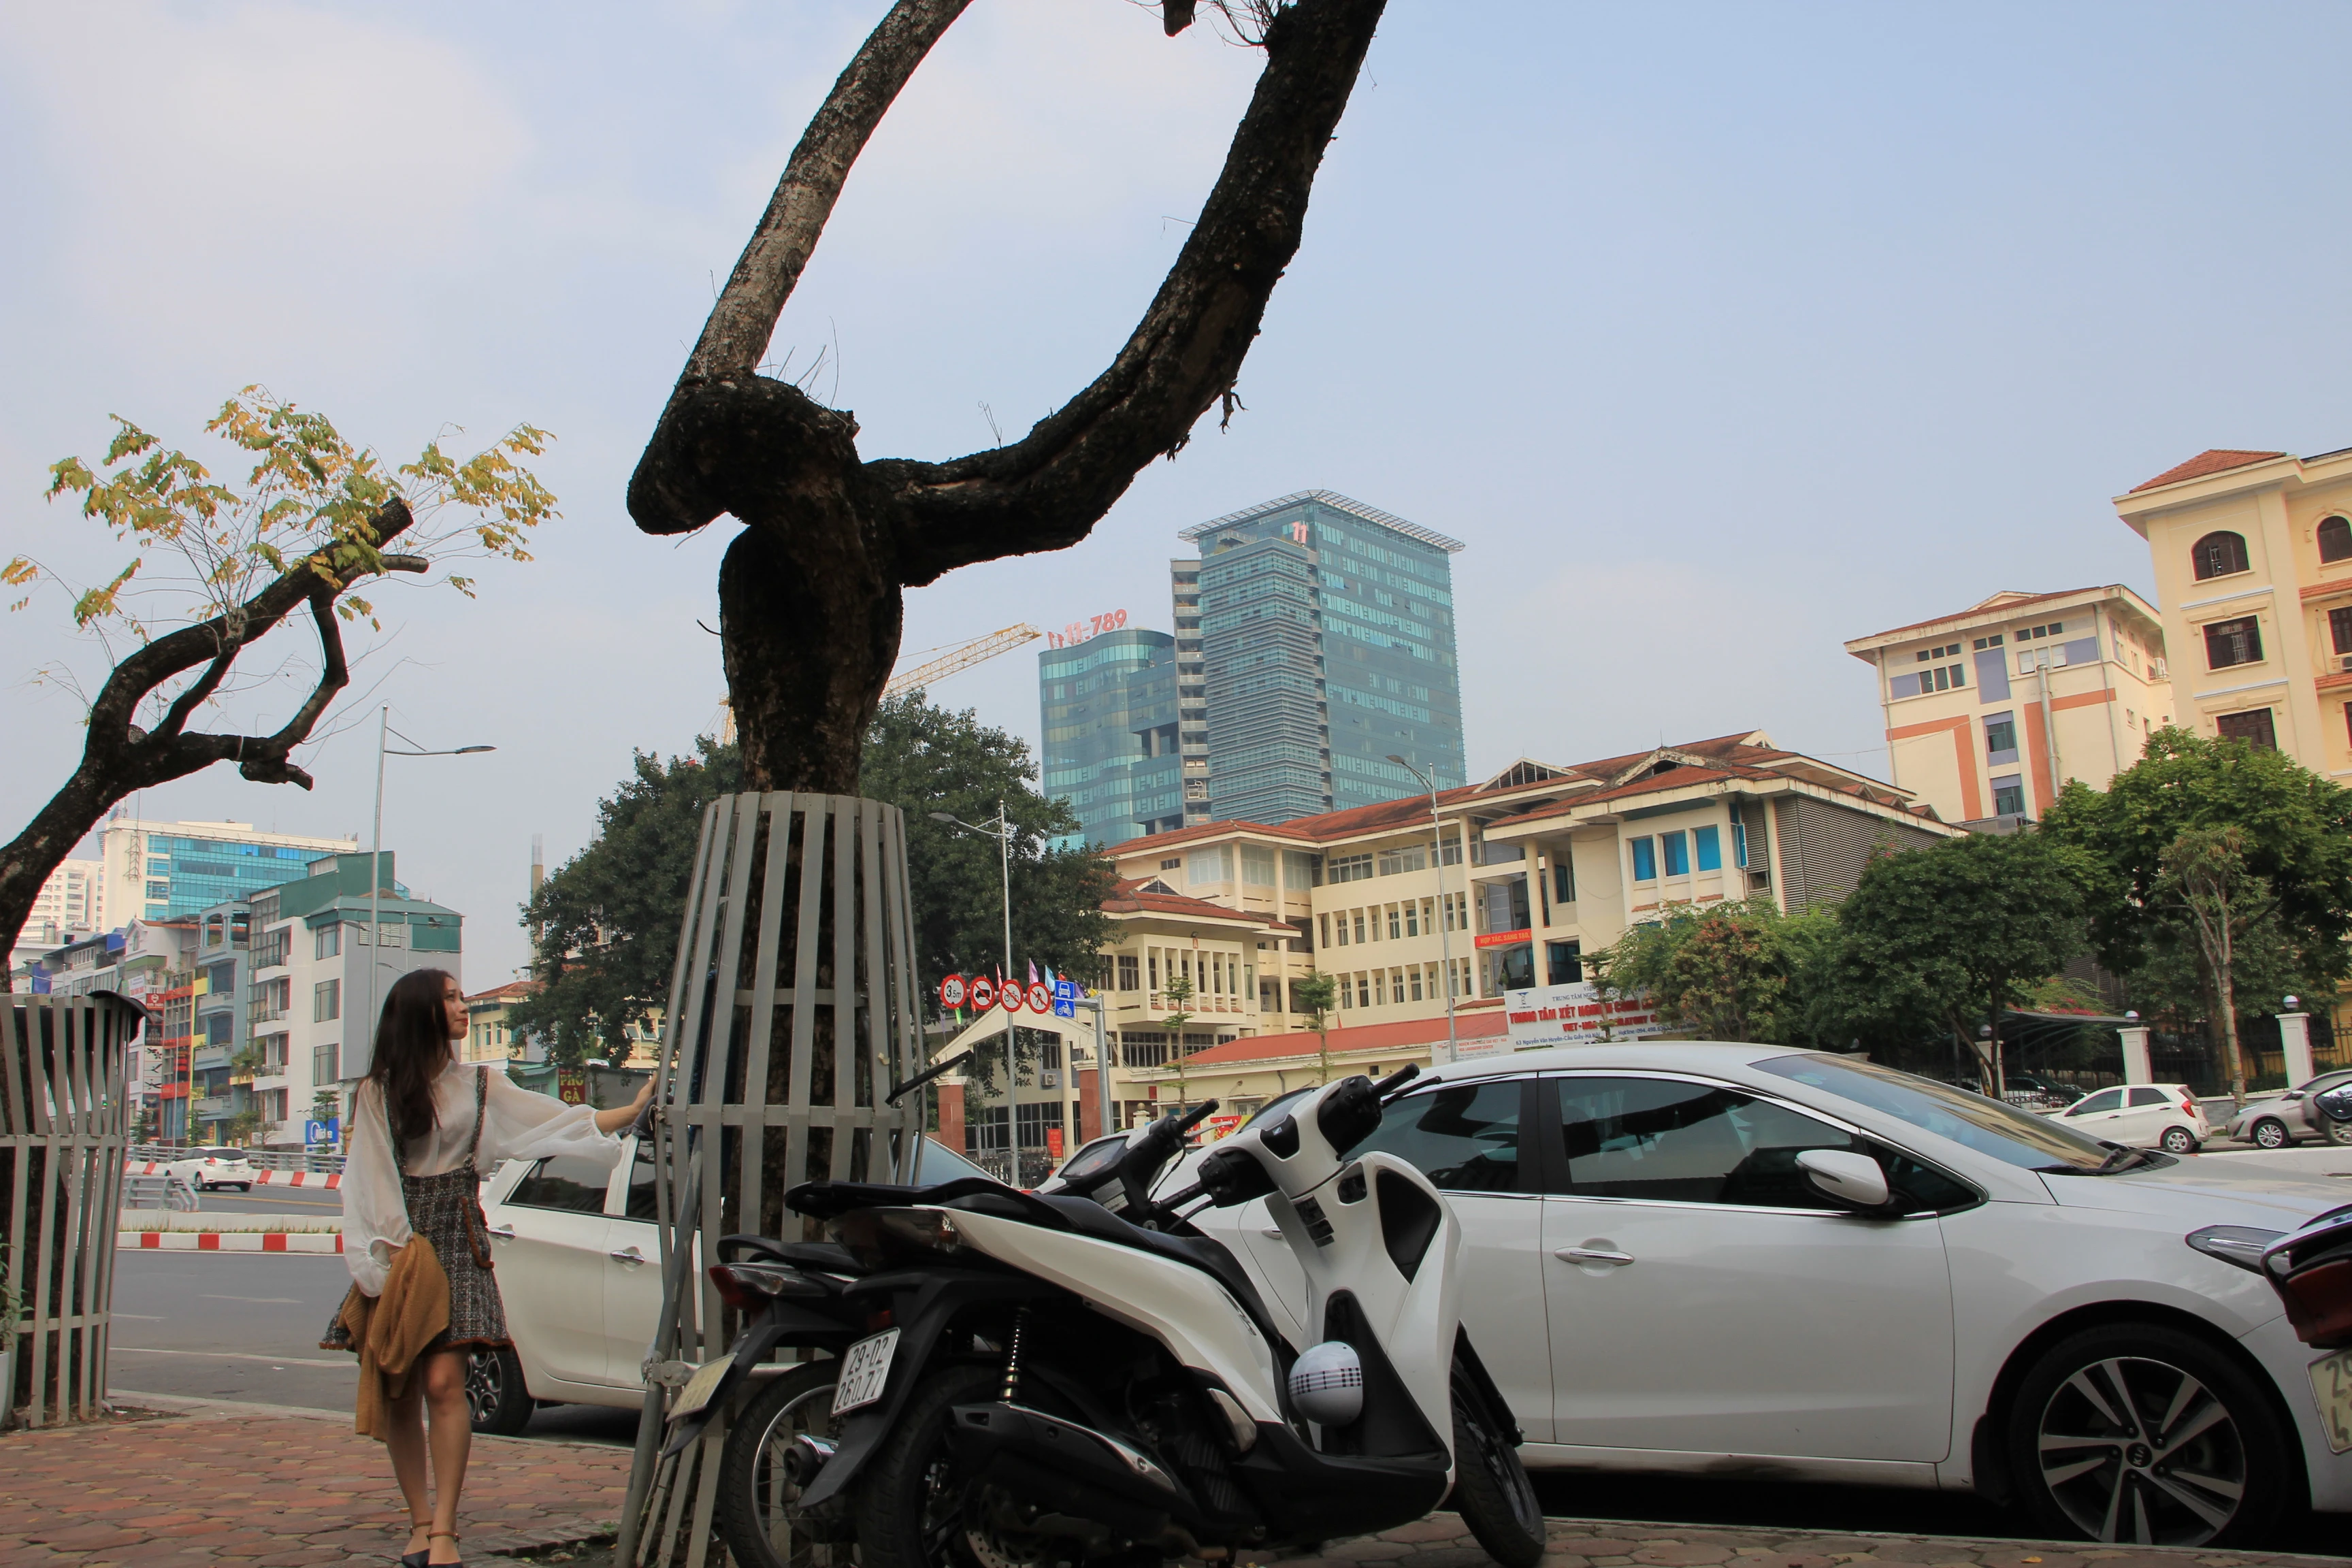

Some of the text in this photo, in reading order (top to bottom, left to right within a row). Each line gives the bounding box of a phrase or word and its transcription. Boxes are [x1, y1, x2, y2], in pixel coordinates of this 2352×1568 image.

[1558, 1004, 1575, 1019] XÉT
[564, 1087, 581, 1102] GÀ
[835, 1367, 884, 1410] 260.77
